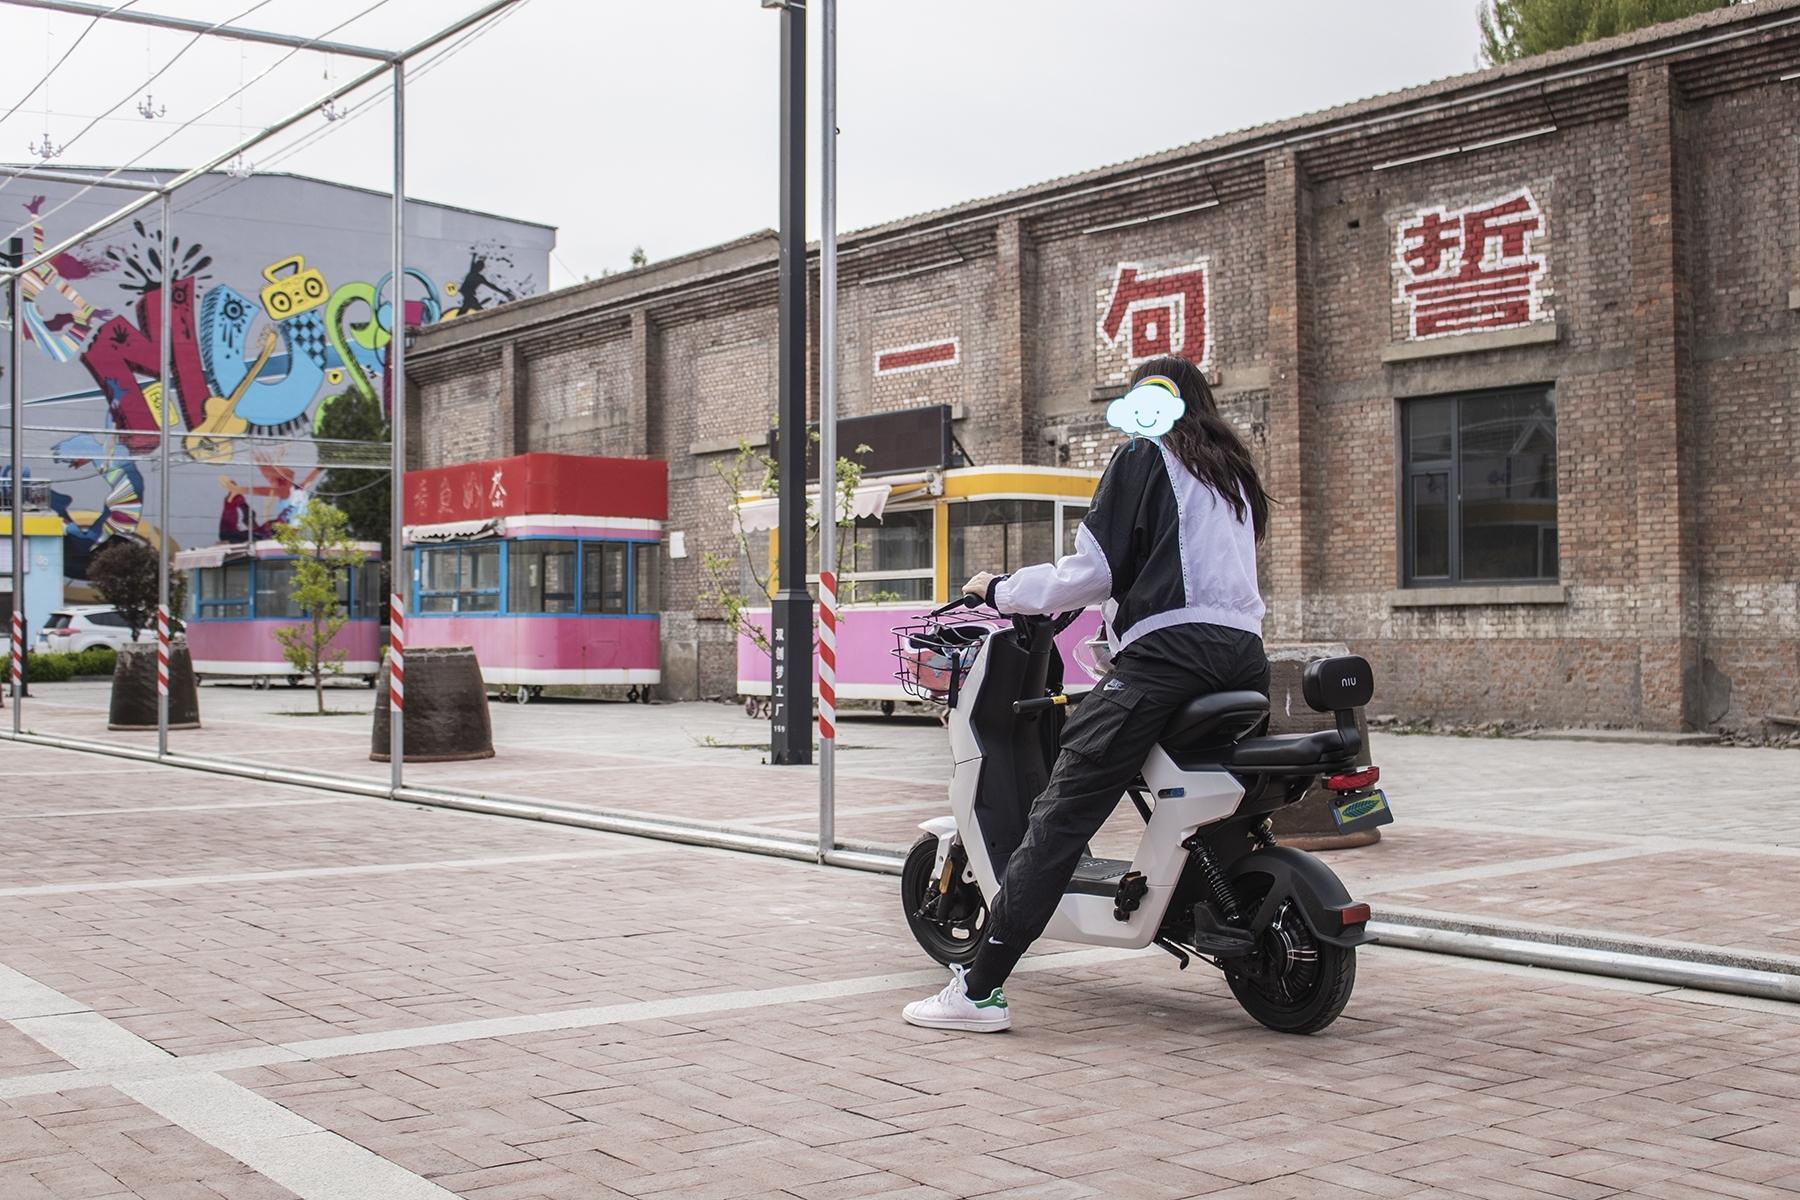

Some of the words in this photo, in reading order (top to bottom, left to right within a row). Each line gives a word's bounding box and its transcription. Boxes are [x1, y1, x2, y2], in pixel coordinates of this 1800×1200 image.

[775, 628, 785, 717] 双创梦工厂
